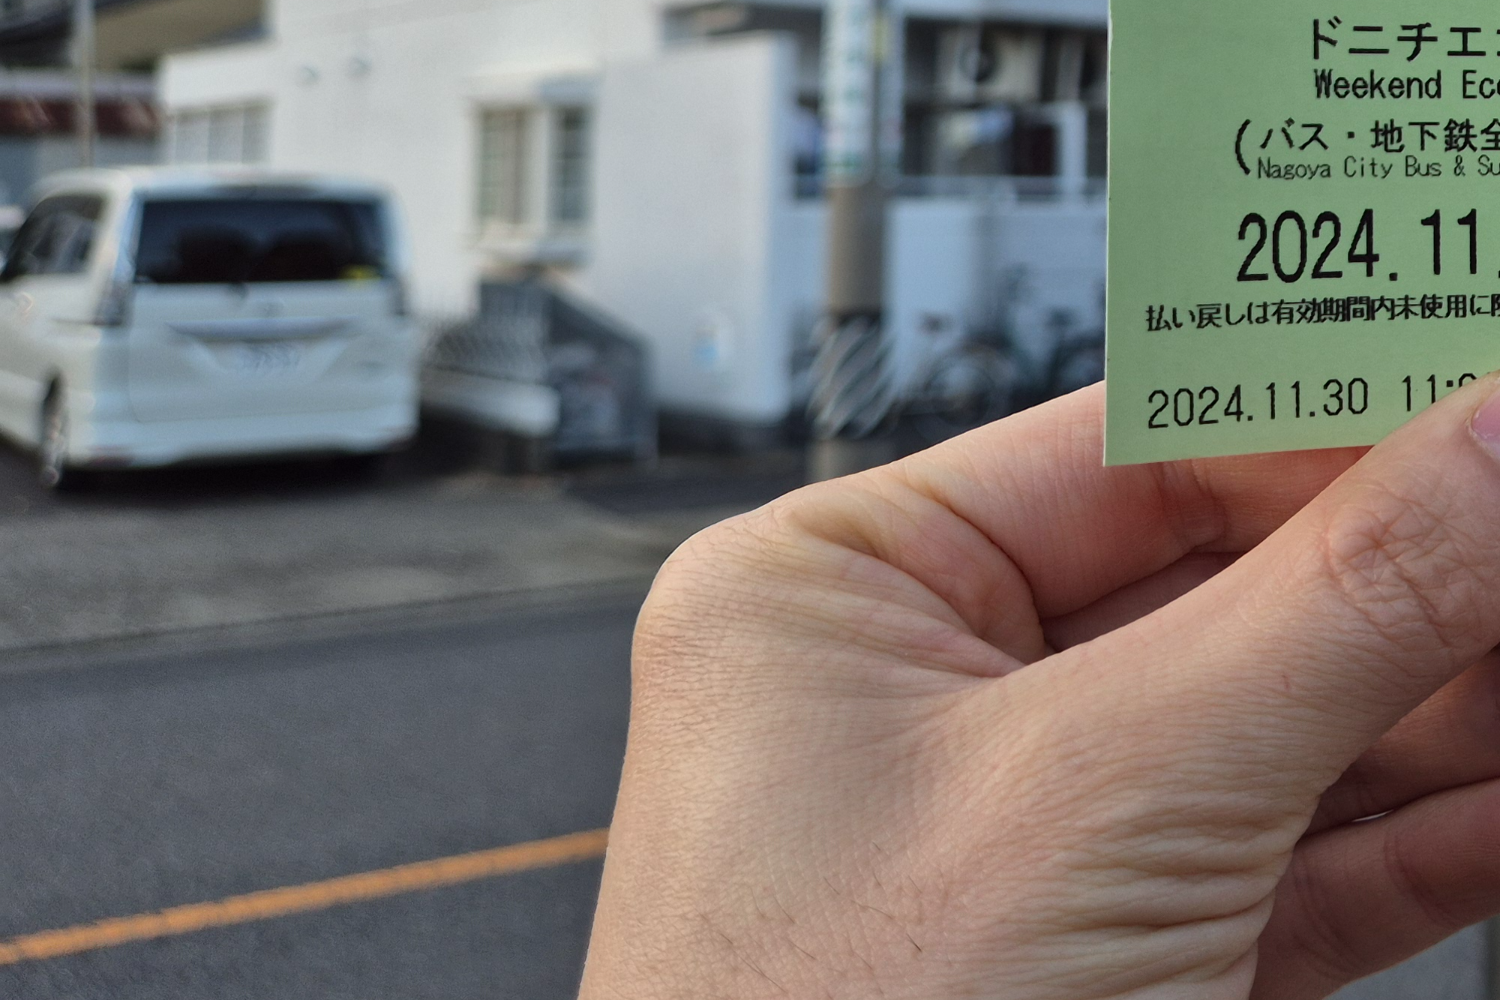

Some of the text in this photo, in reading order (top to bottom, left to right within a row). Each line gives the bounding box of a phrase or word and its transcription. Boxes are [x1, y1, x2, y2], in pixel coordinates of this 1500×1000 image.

[1314, 69, 1442, 99] Weekend
[1258, 157, 1331, 181] Nagoya
[1344, 156, 1393, 179] City
[1405, 155, 1442, 178] Bus
[1454, 155, 1466, 177] &
[1148, 377, 1369, 430] 2024.11.30
[1402, 373, 1478, 412] 11:
